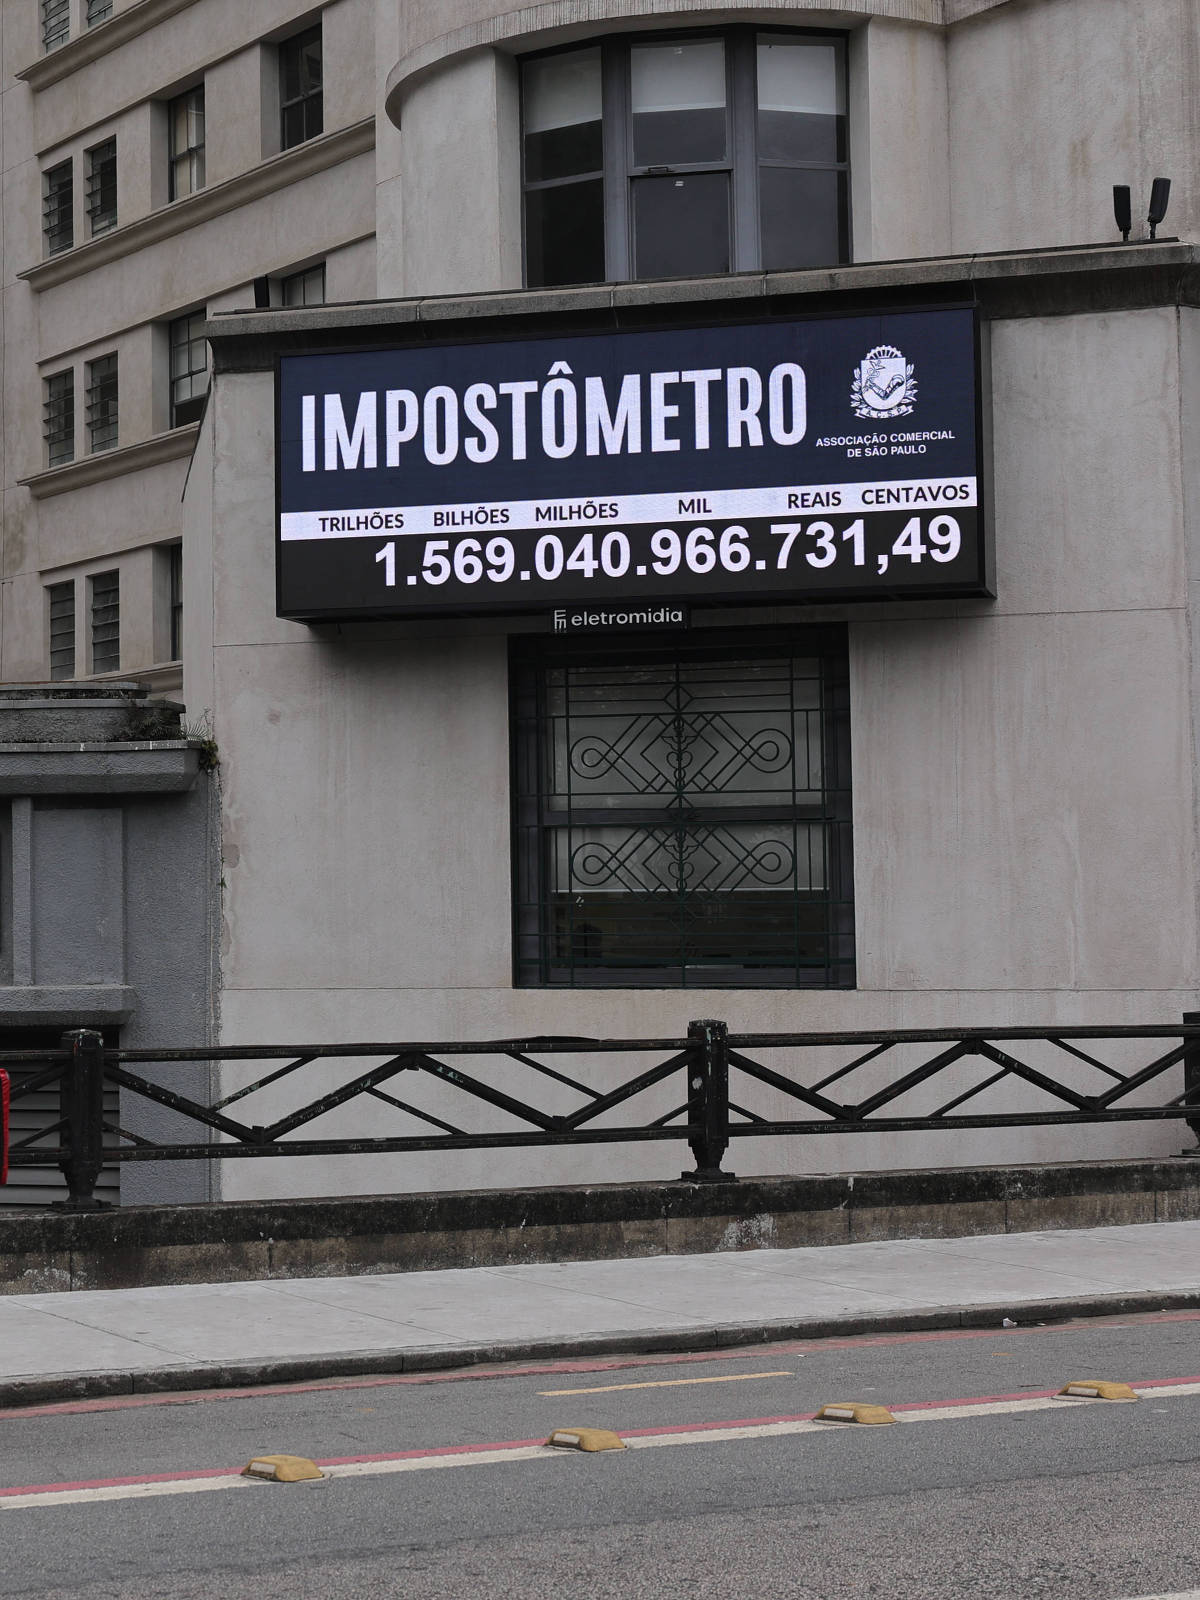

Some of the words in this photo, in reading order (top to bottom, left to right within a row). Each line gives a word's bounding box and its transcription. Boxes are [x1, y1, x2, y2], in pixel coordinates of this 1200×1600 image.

[302, 360, 807, 472] IMPOSTÔMETRO
[815, 432, 887, 448] ASSOCIAÇÃO
[890, 430, 955, 442] COMERCIAL
[847, 448, 862, 458] DE
[864, 445, 888, 457] SÃO
[891, 444, 927, 455] PAULO
[318, 511, 405, 532] TRILHÕES
[433, 506, 510, 527] BILHÕES
[535, 501, 619, 522] MILHÕES
[678, 498, 712, 515] MIL
[787, 491, 842, 509] REAIS
[861, 484, 970, 505] CENTAVOS
[375, 514, 961, 587] 1.569.040.966.731,49
[571, 607, 683, 626] eletromidia
